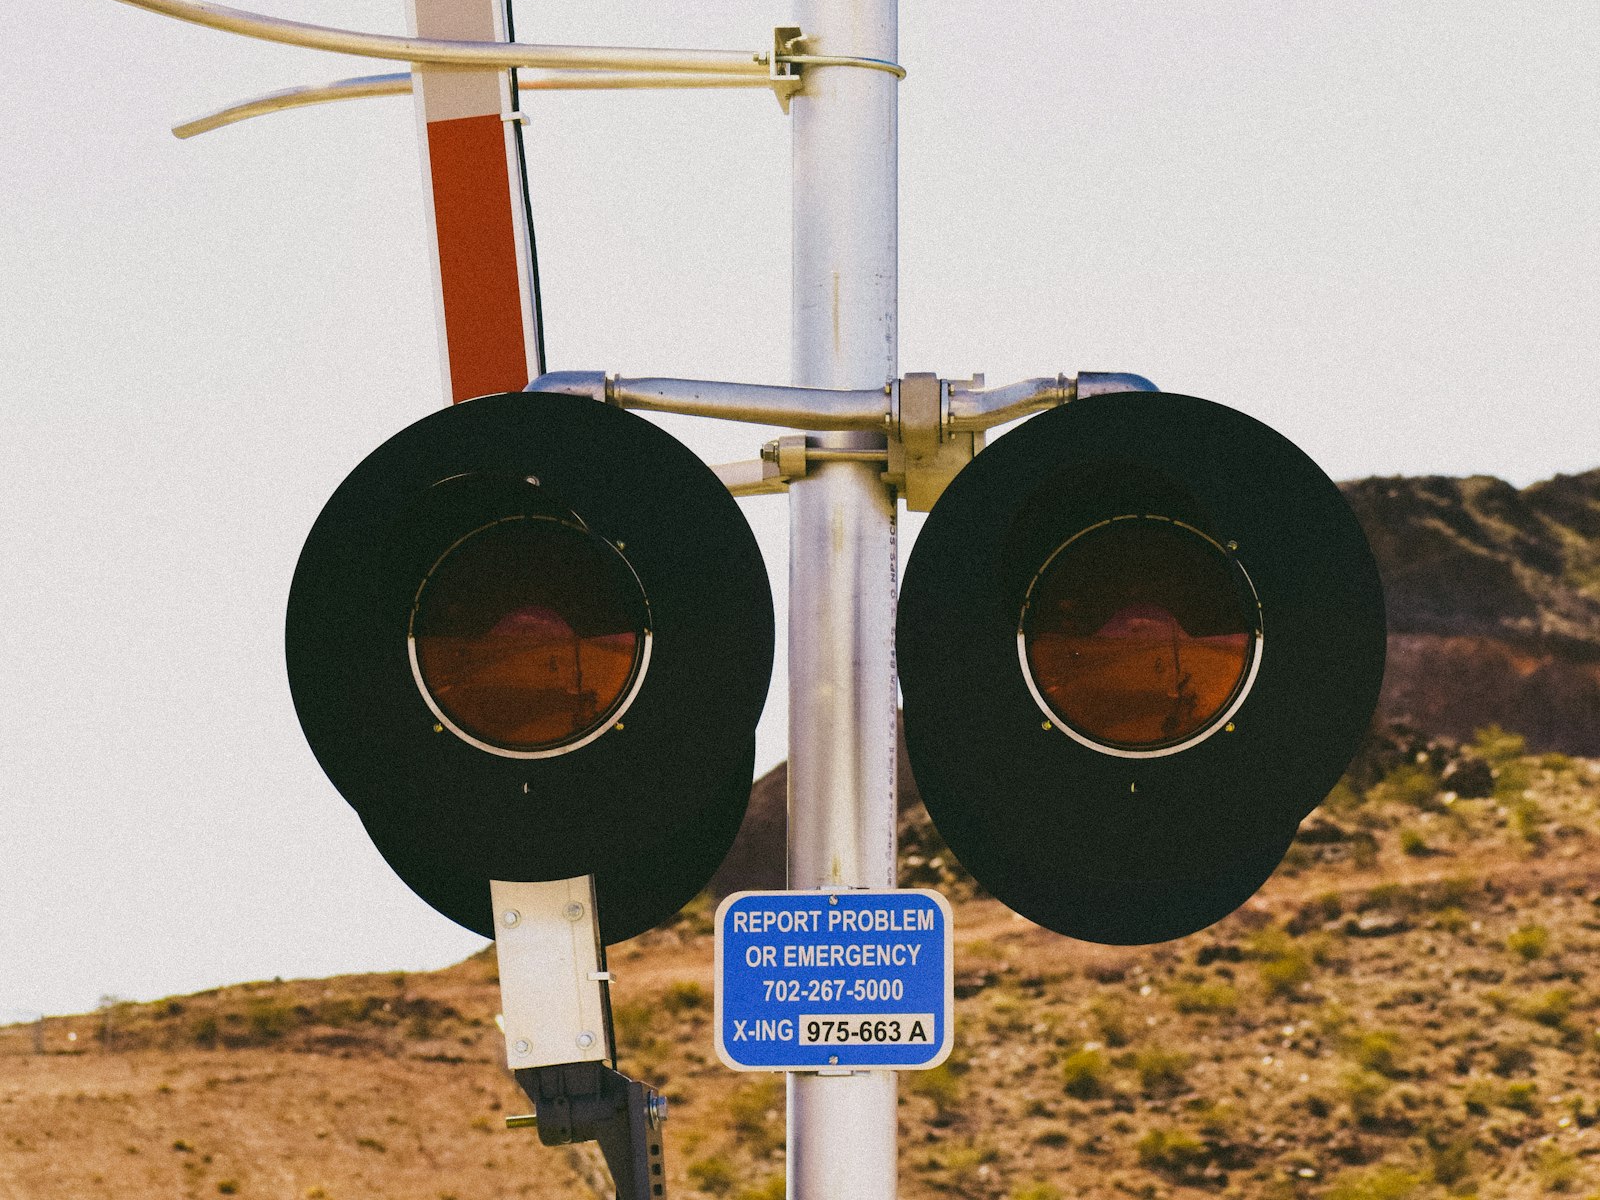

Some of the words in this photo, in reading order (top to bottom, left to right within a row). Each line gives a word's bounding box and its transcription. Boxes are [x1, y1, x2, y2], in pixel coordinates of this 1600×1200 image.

[733, 910, 822, 933] REPORT
[828, 908, 935, 932] PROBLEM
[745, 945, 777, 968] OR
[783, 943, 922, 967] EMERGENCY
[762, 978, 904, 1002] 702-267-5000
[732, 1019, 794, 1042] X-ING
[807, 1020, 902, 1043] 975-663
[908, 1020, 927, 1042] A
